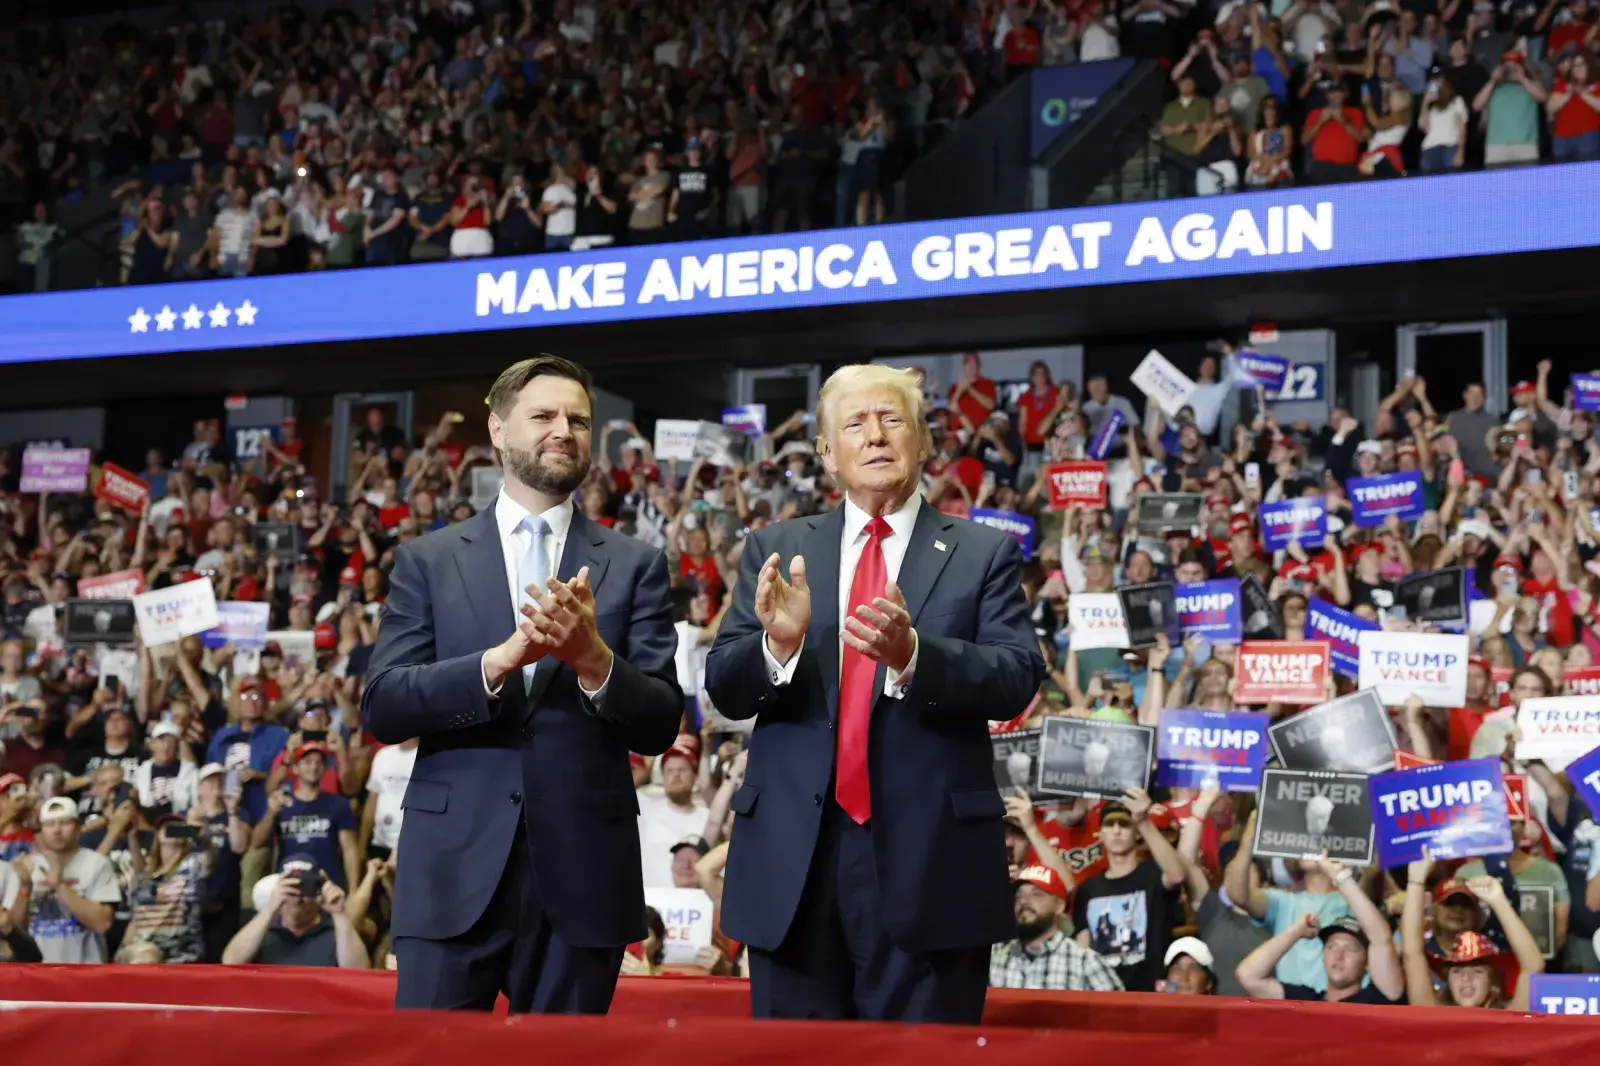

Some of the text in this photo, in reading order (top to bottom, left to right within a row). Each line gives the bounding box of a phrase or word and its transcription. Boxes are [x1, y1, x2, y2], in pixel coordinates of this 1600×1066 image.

[476, 202, 1333, 316] MAKE AMERICA GREAT AGAIN
[1240, 358, 1285, 374] TRUMP
[1051, 471, 1104, 486] TRUMP
[1353, 481, 1418, 502] TRUMP
[973, 515, 1031, 536] TRUMP
[1263, 506, 1323, 526] TRUMP
[1080, 607, 1121, 618] TRU
[1175, 594, 1235, 614] RUMP
[1240, 653, 1323, 670] TRUMP
[1371, 651, 1457, 667] TRUMP
[1248, 668, 1315, 684] VANCE
[1380, 668, 1447, 683] VANCE
[1057, 726, 1138, 752] NEVER
[1167, 726, 1260, 750] TRUMP
[993, 740, 1038, 761] EVE
[1044, 771, 1134, 791] SURREND
[1277, 781, 1363, 805] NEVER
[1379, 780, 1493, 816] TRUMP
[281, 818, 331, 834] TRUMP
[1394, 802, 1484, 832] VANCE
[1261, 831, 1367, 853] SURRENDER
[666, 908, 702, 924] MP
[665, 926, 690, 940] CE
